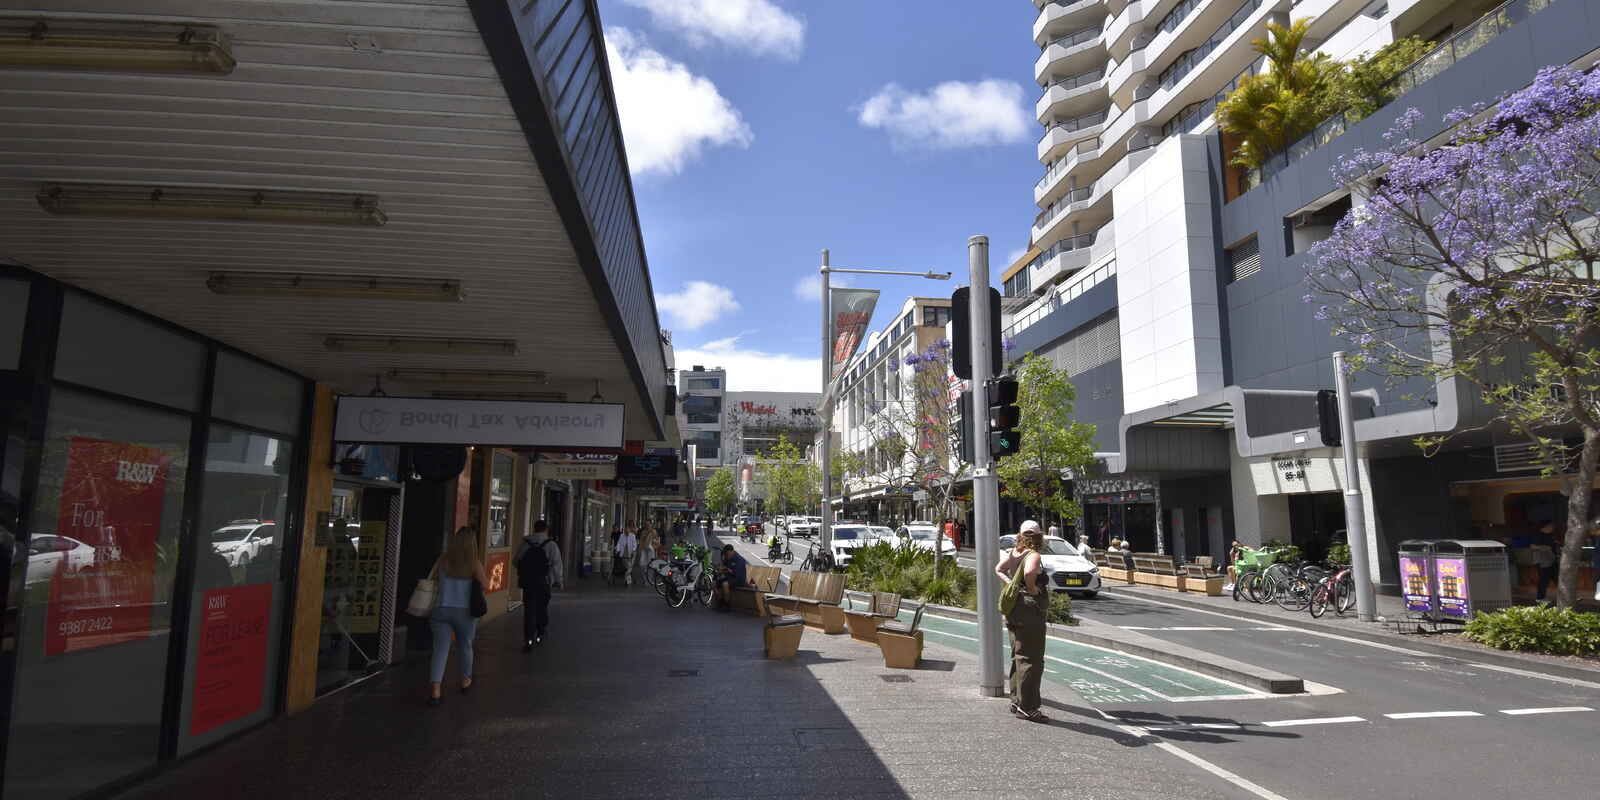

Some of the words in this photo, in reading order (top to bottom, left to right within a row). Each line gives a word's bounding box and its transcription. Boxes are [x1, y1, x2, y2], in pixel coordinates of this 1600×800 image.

[741, 401, 777, 414] Westfield
[115, 460, 159, 483] R&W
[71, 502, 105, 528] For
